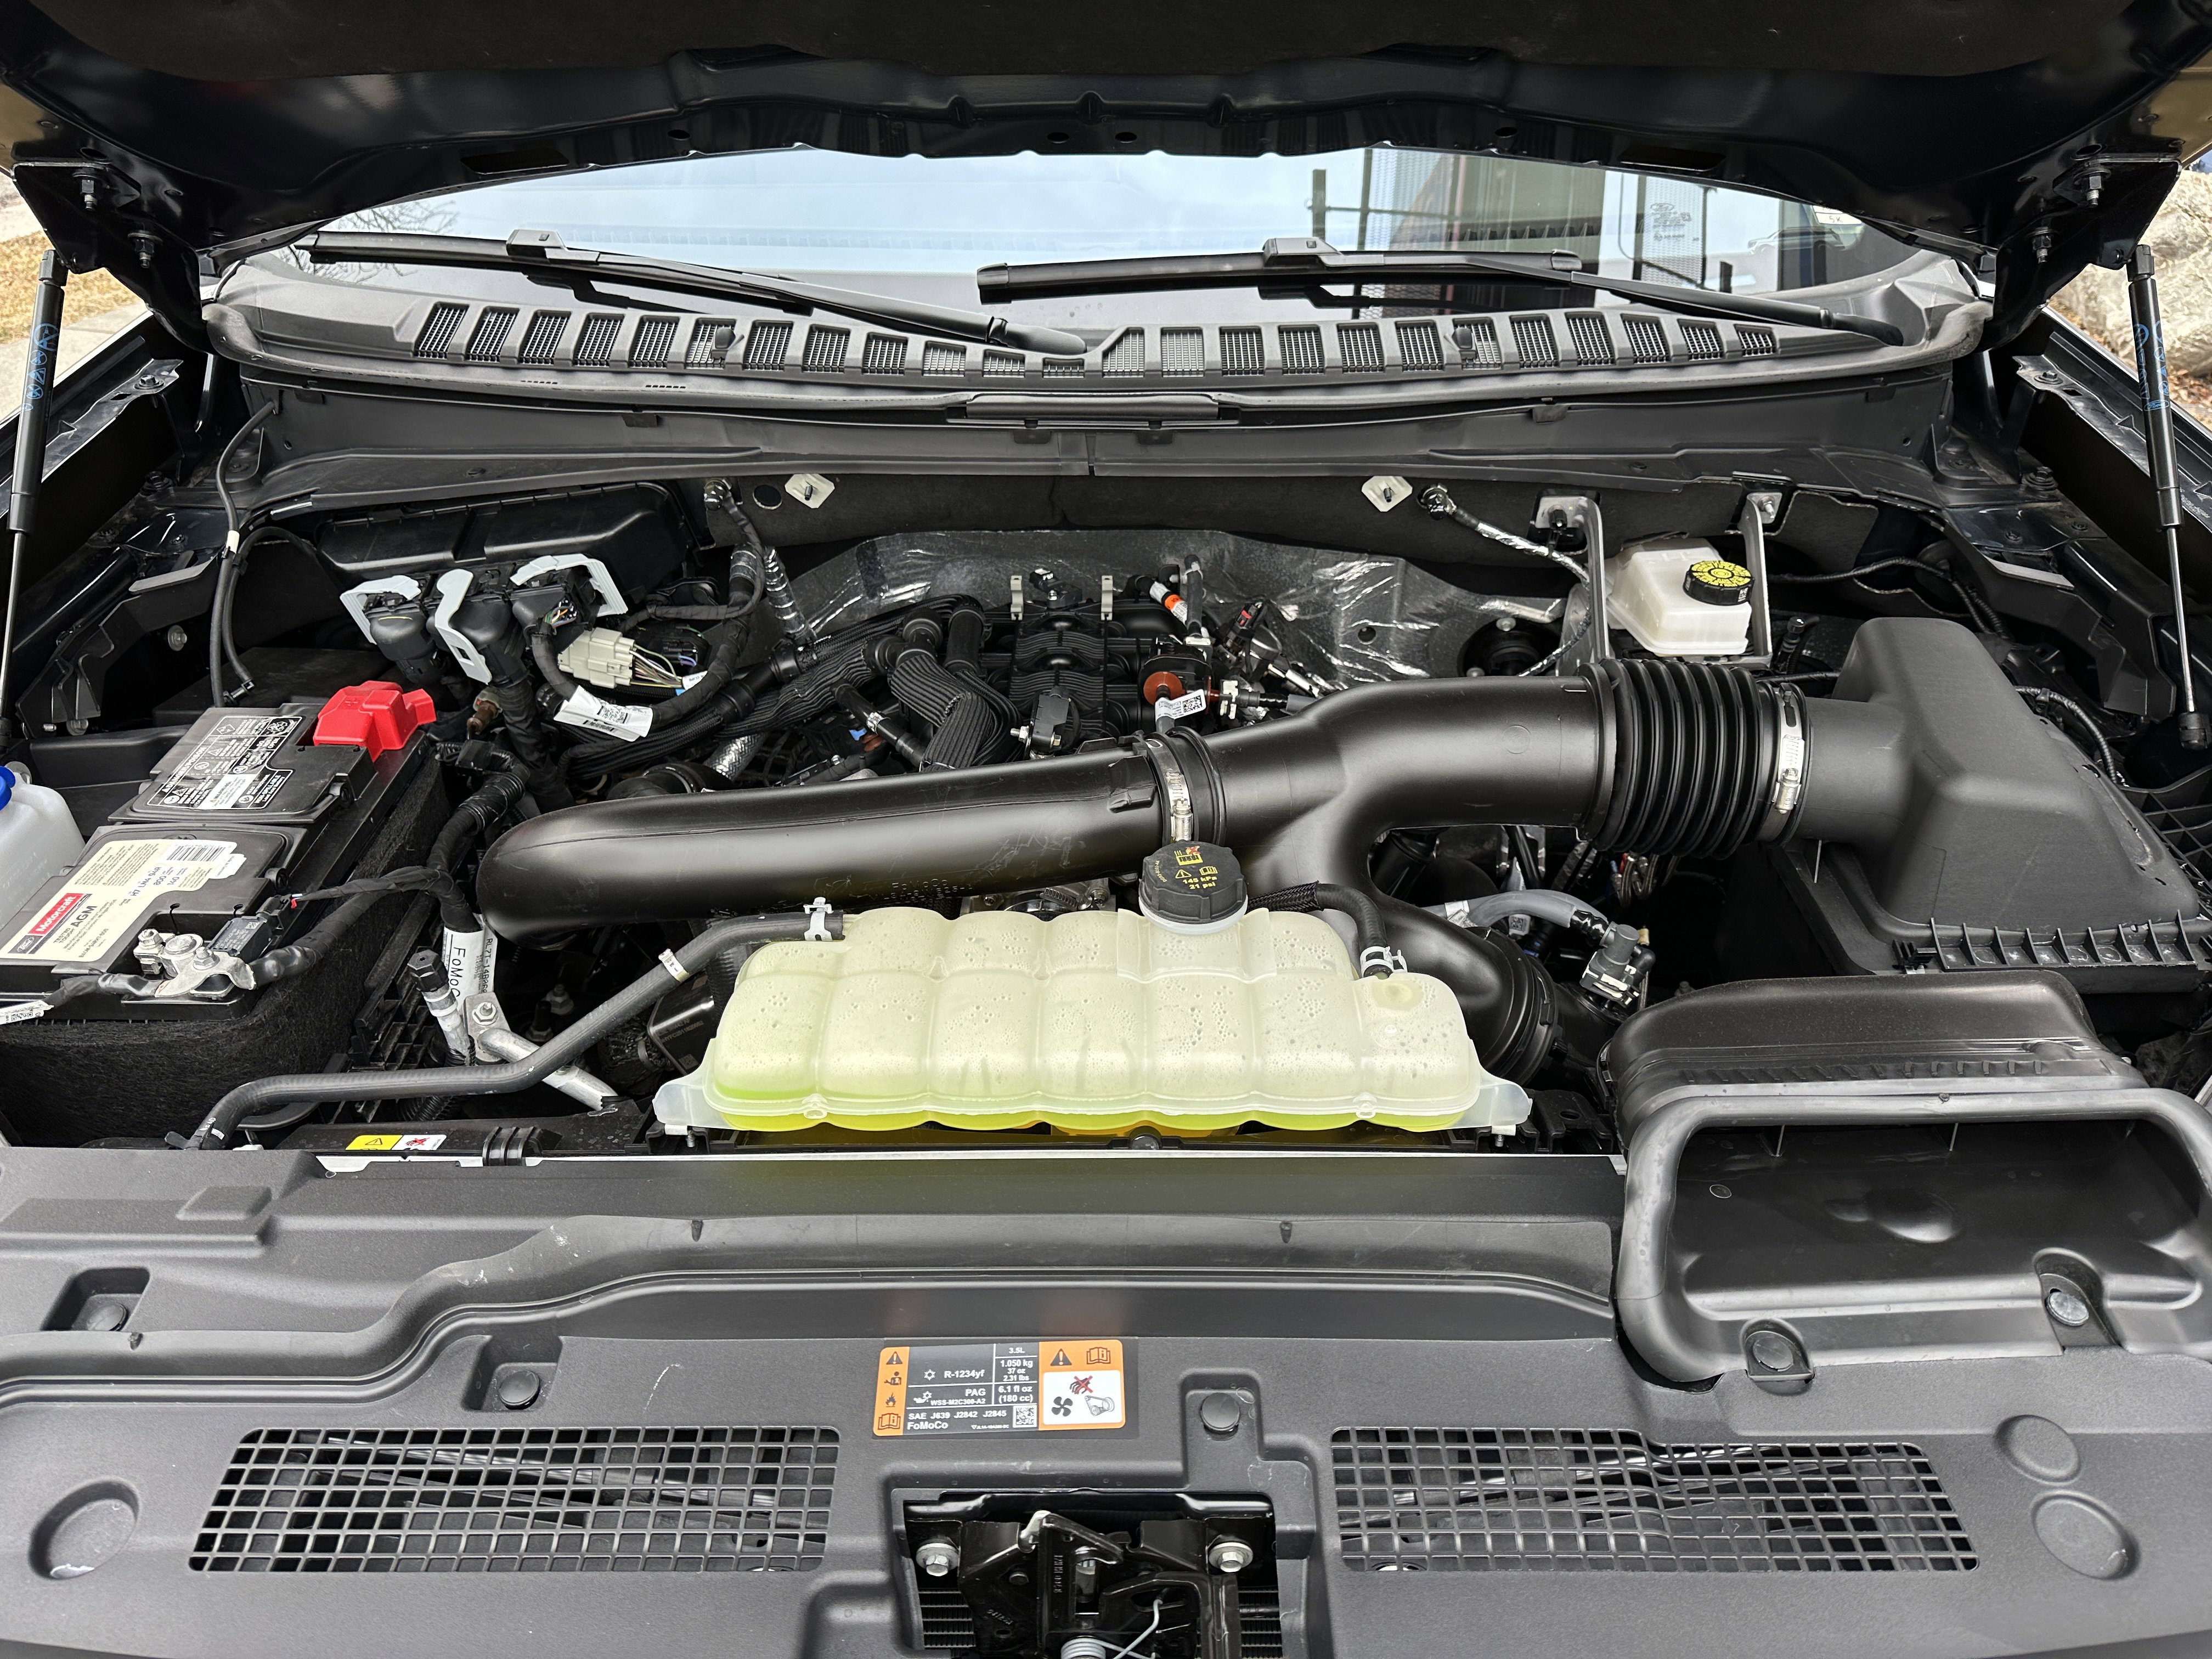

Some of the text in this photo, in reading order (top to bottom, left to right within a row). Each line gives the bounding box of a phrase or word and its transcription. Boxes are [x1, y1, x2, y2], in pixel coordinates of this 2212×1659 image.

[167, 877, 179, 885] 140
[35, 896, 77, 932] Motorcraft
[70, 906, 98, 927] AGM
[1023, 1359, 1033, 1368] kg
[944, 1369, 985, 1379] R-1234yf
[965, 1389, 986, 1397] PAG
[998, 1395, 1017, 1403] (180
[907, 1422, 949, 1430] FoMoCo
